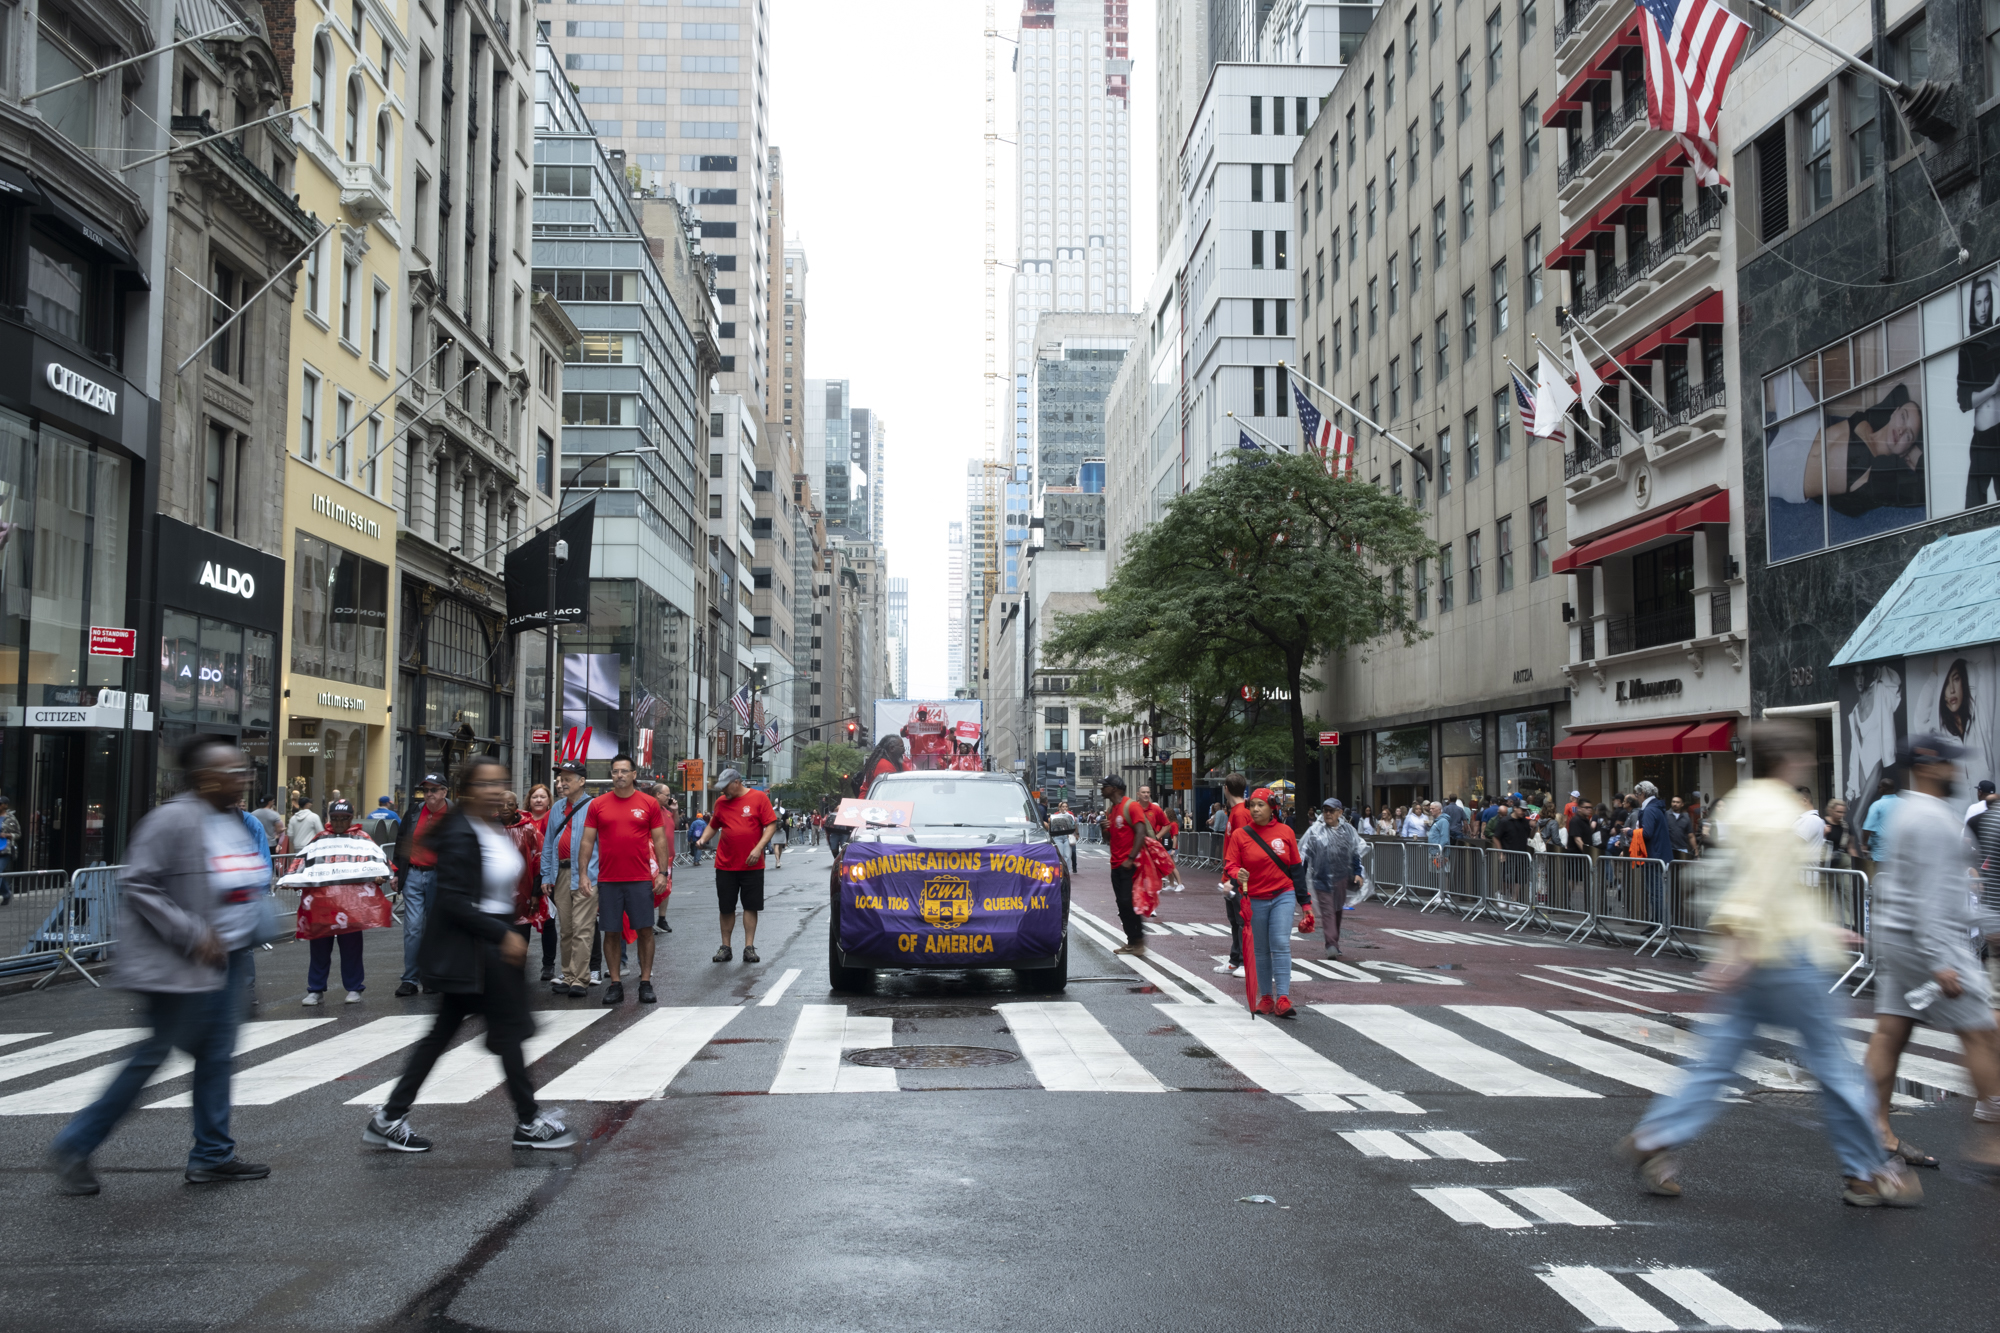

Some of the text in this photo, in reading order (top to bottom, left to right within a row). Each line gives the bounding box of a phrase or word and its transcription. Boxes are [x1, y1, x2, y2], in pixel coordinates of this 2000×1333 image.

[82, 226, 104, 247] BULOVA
[46, 362, 117, 416] CITIZEN
[312, 493, 381, 540] intimissimi
[199, 560, 255, 599] ALDO
[102, 630, 129, 638] STANDING
[180, 664, 222, 682] ADO
[1513, 668, 1534, 684] ARITZIA
[1791, 665, 1813, 687] 608
[98, 689, 150, 712] CITIEN
[317, 691, 366, 711] intimissimi
[35, 711, 87, 723] CITIZEN
[325, 855, 349, 863] LOCAL
[849, 851, 1054, 884] COMMUNICATIONS WORKERS
[927, 883, 965, 899] CWA
[855, 895, 1049, 912] LOCAL 1106 QUEENS, N.Y.
[898, 933, 994, 953] OF AMERICA
